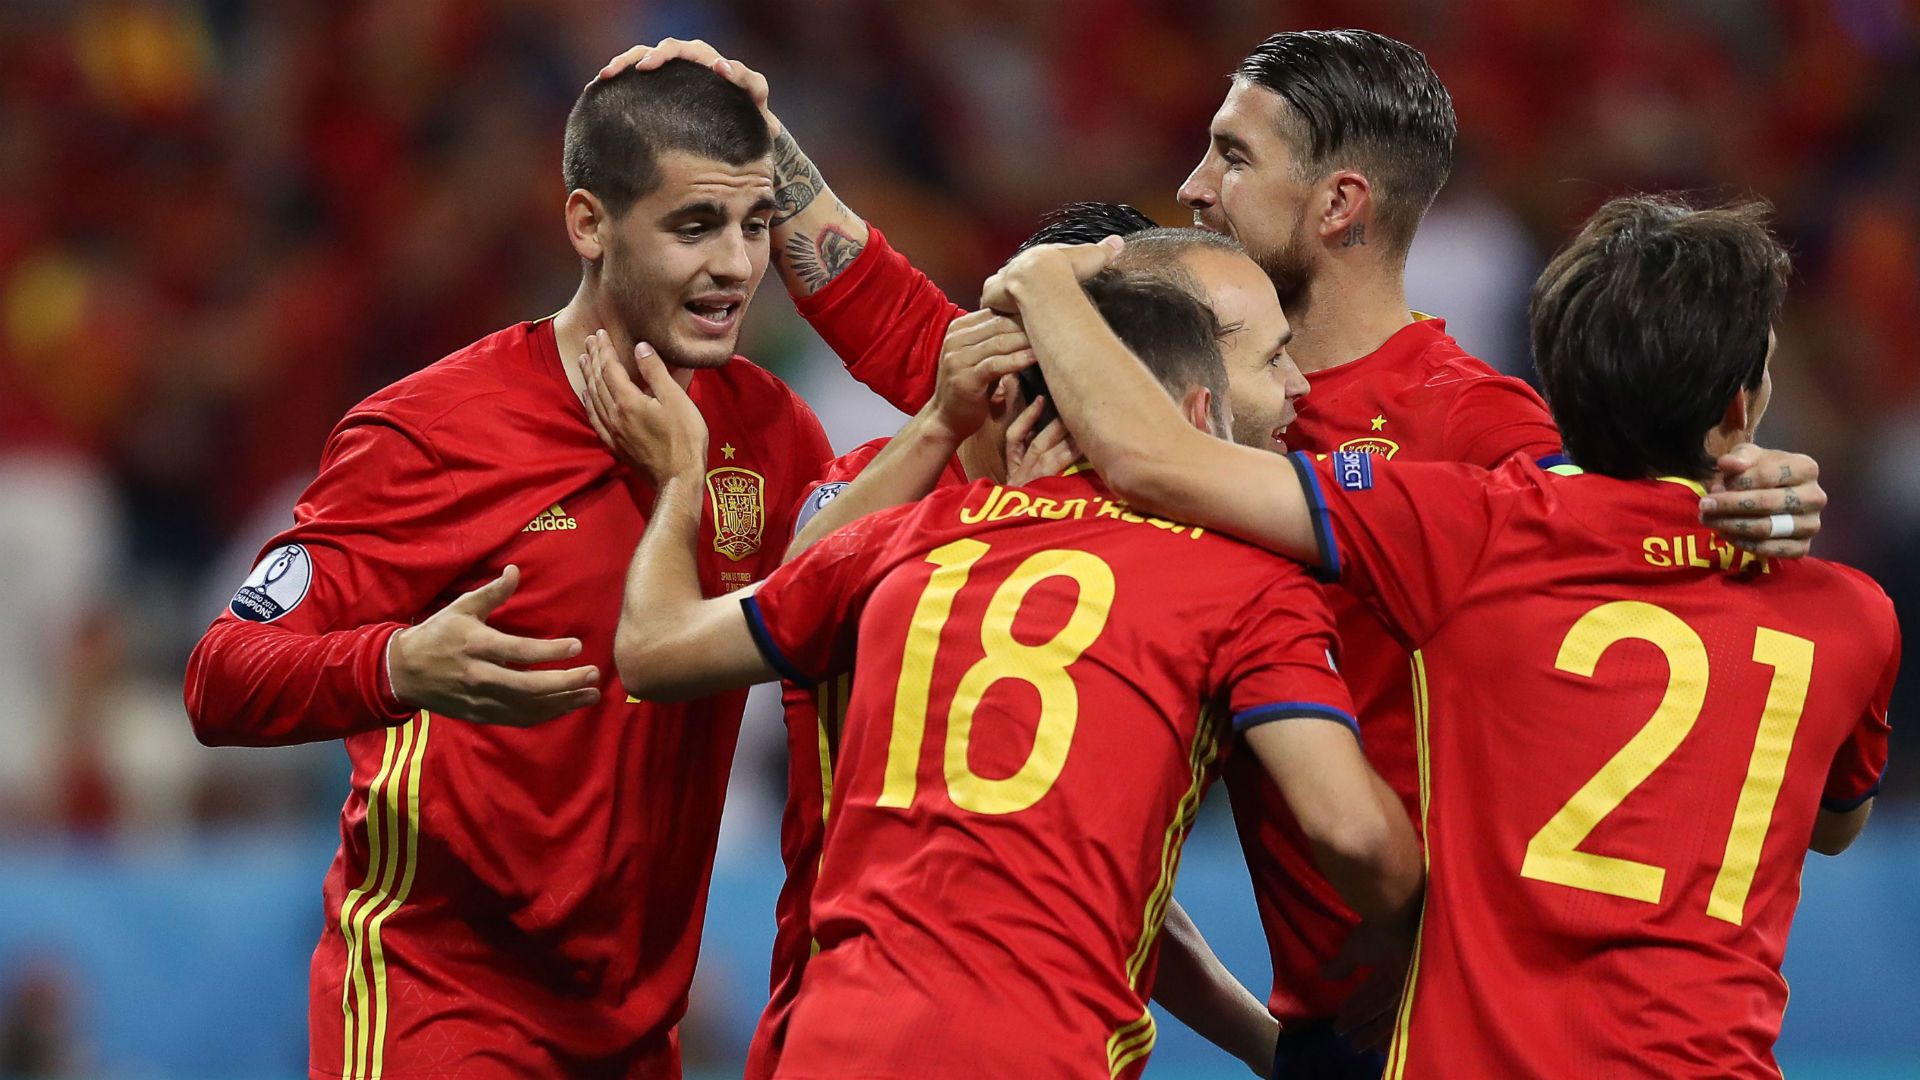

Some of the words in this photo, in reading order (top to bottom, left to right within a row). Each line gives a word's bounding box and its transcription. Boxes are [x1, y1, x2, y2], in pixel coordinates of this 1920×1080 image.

[249, 591, 264, 603] EURO
[262, 600, 277, 612] 2012
[875, 537, 1116, 815] 18
[1520, 600, 1815, 926] 21
